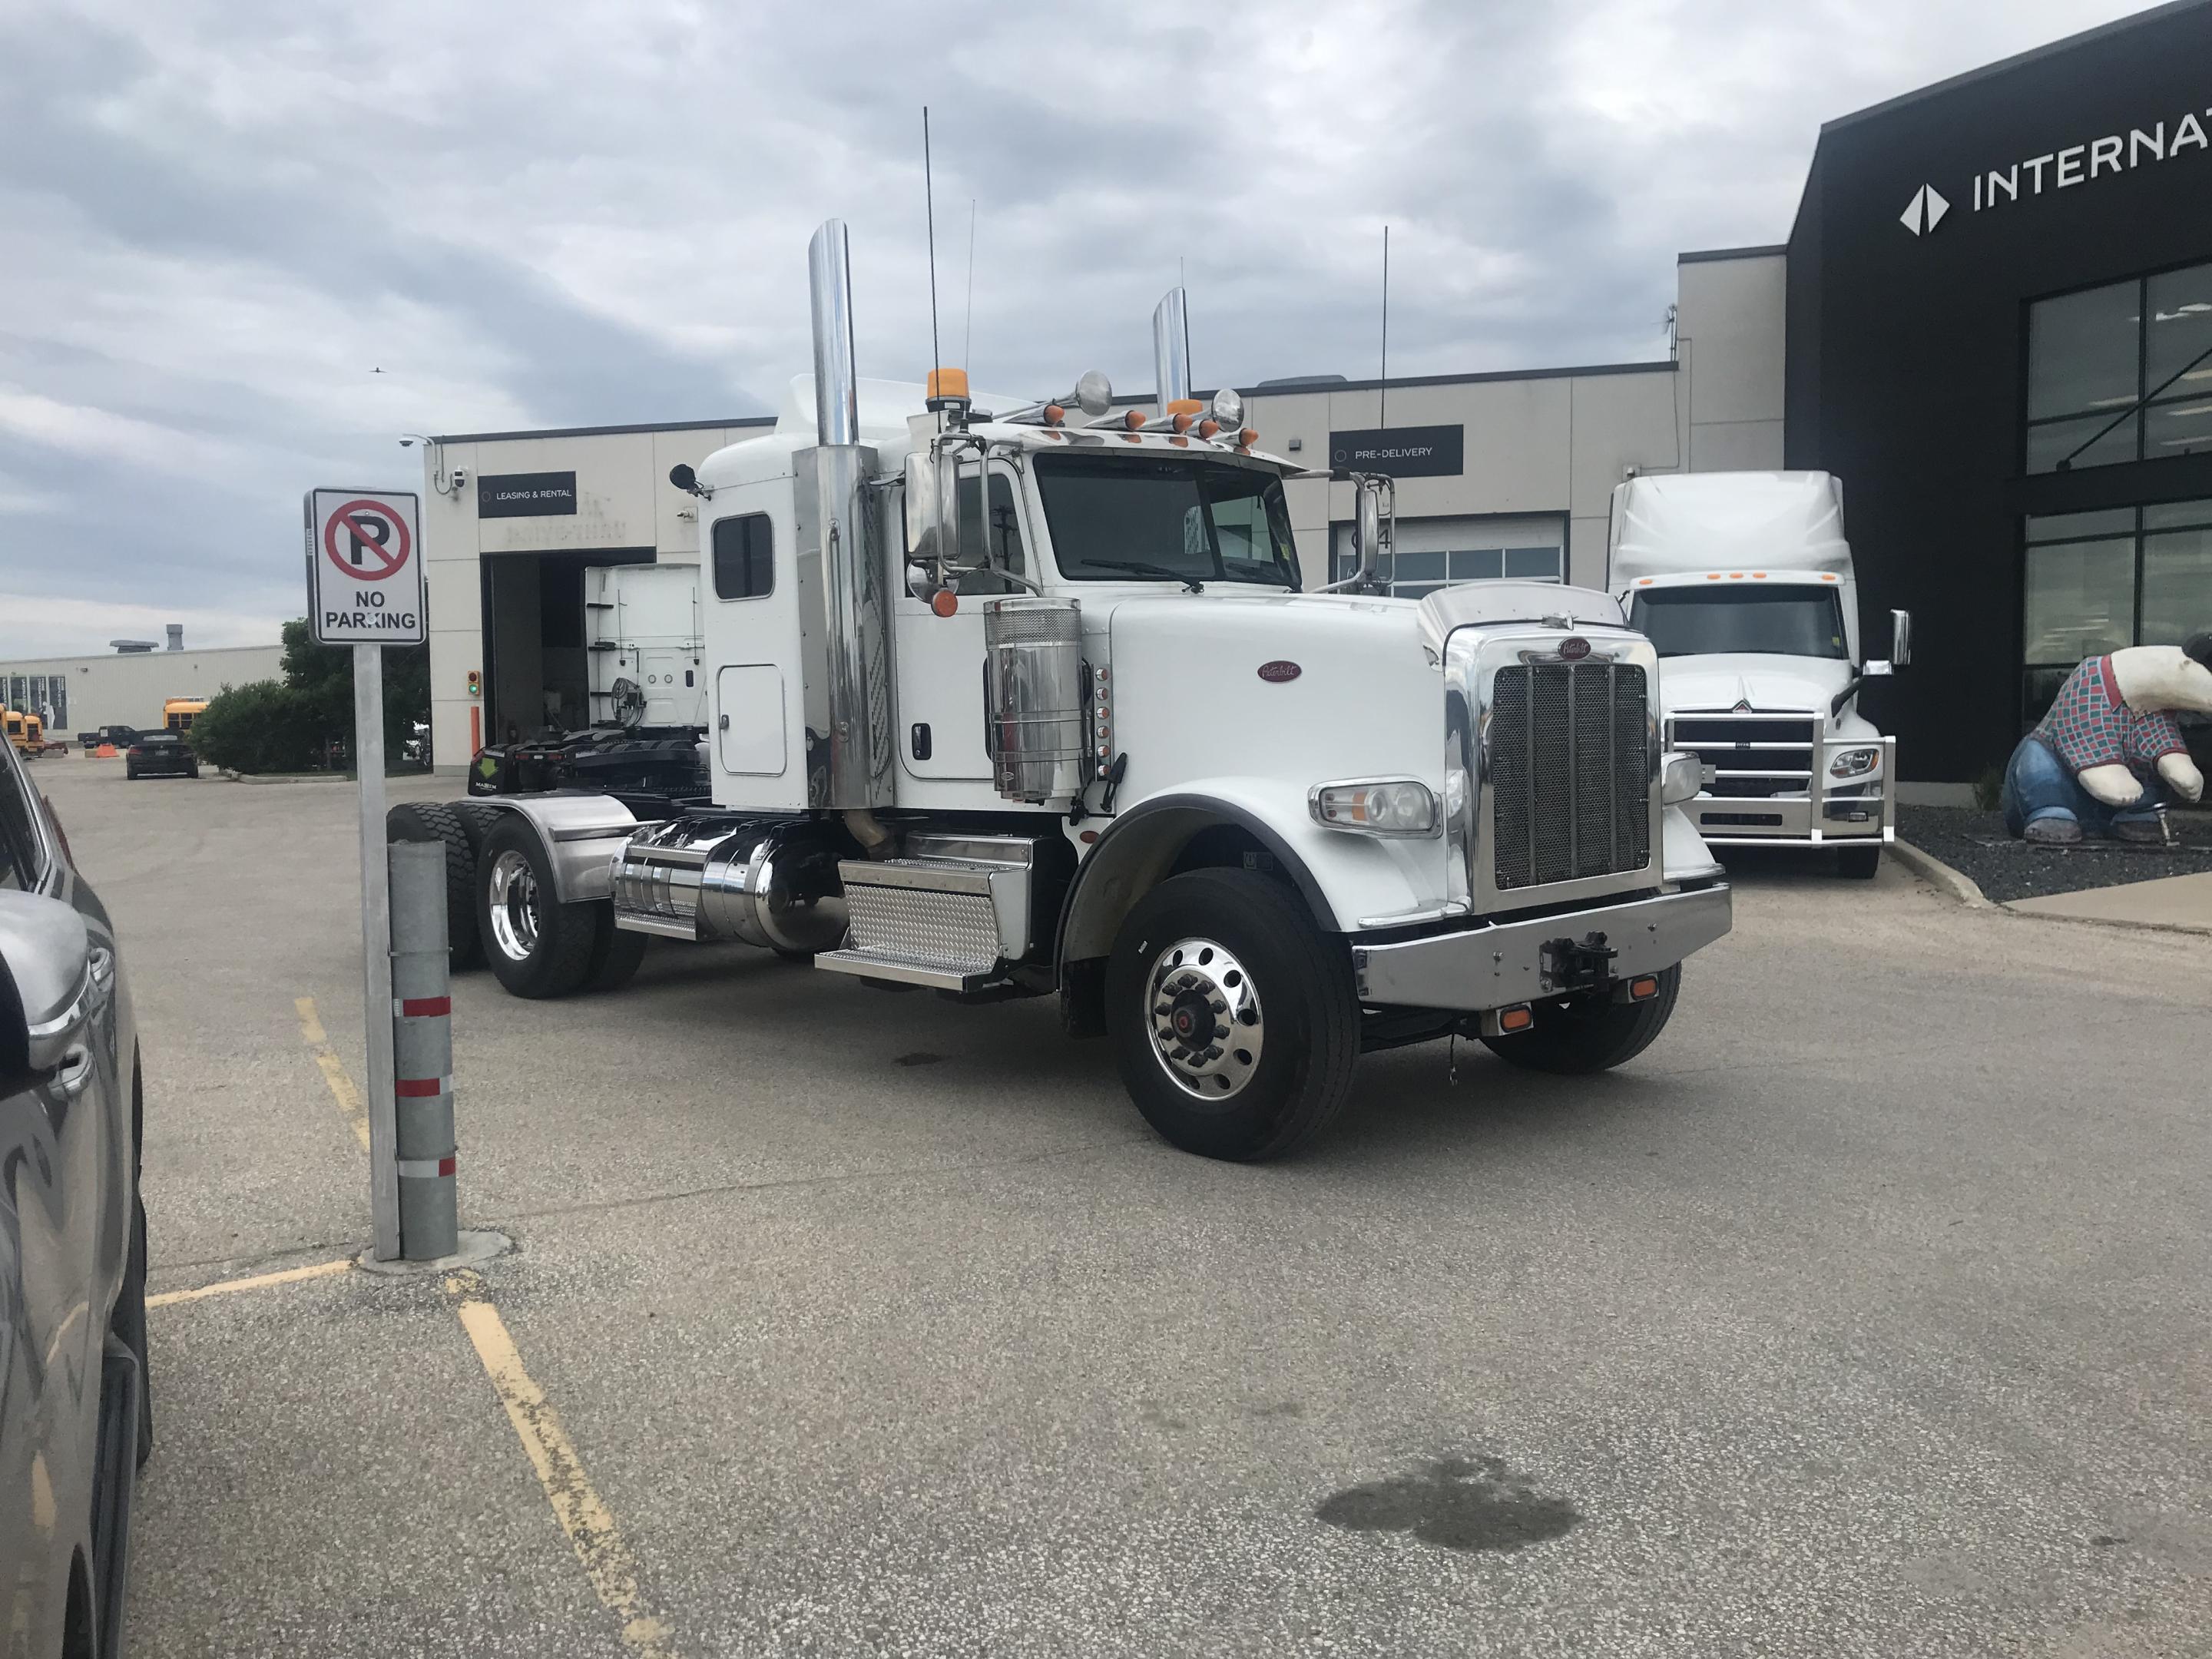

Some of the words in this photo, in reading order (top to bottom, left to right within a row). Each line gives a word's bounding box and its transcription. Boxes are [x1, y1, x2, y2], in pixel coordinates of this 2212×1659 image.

[1974, 108, 2212, 212] INTERNA
[1355, 447, 1432, 459] PRE-DELIVERY
[496, 492, 531, 500] LEASING
[540, 489, 572, 498] RENTAL
[356, 591, 385, 608] NO
